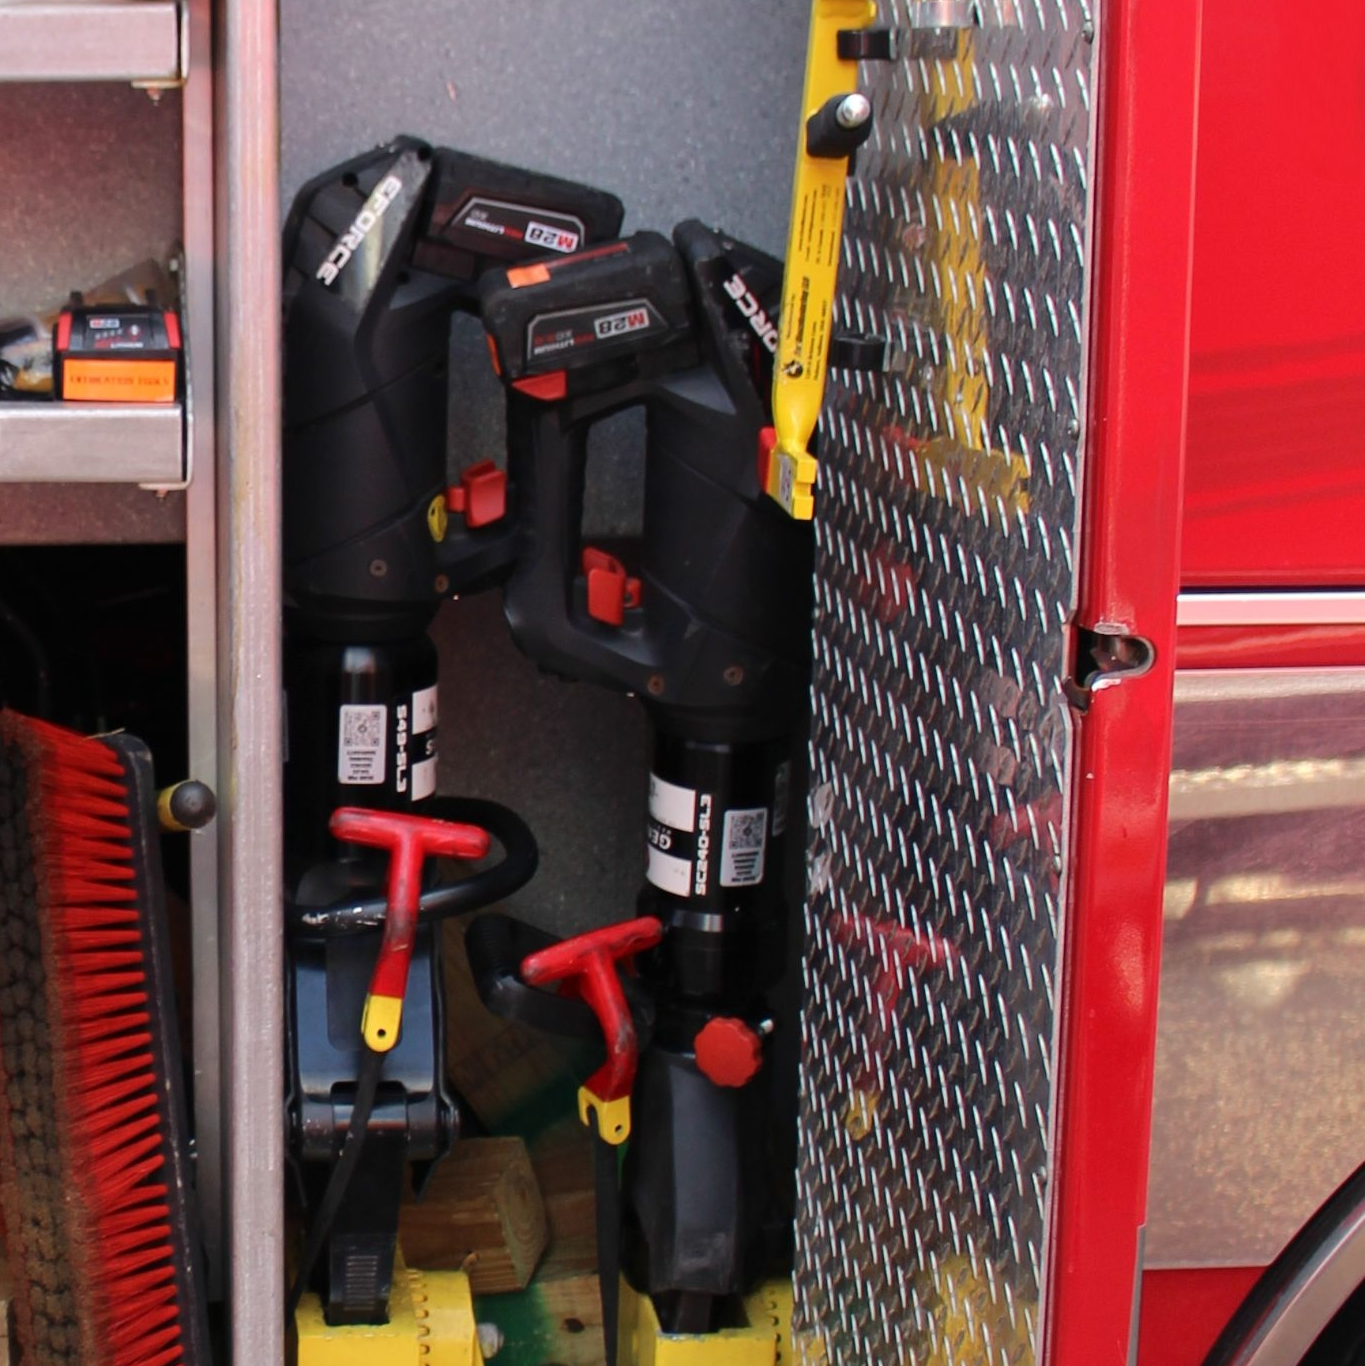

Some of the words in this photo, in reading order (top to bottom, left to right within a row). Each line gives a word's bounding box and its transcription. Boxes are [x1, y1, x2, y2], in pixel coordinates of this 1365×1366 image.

[316, 176, 402, 285] EFORCE
[528, 227, 576, 251] M28
[598, 311, 648, 335] M28
[723, 273, 777, 353] ORCE
